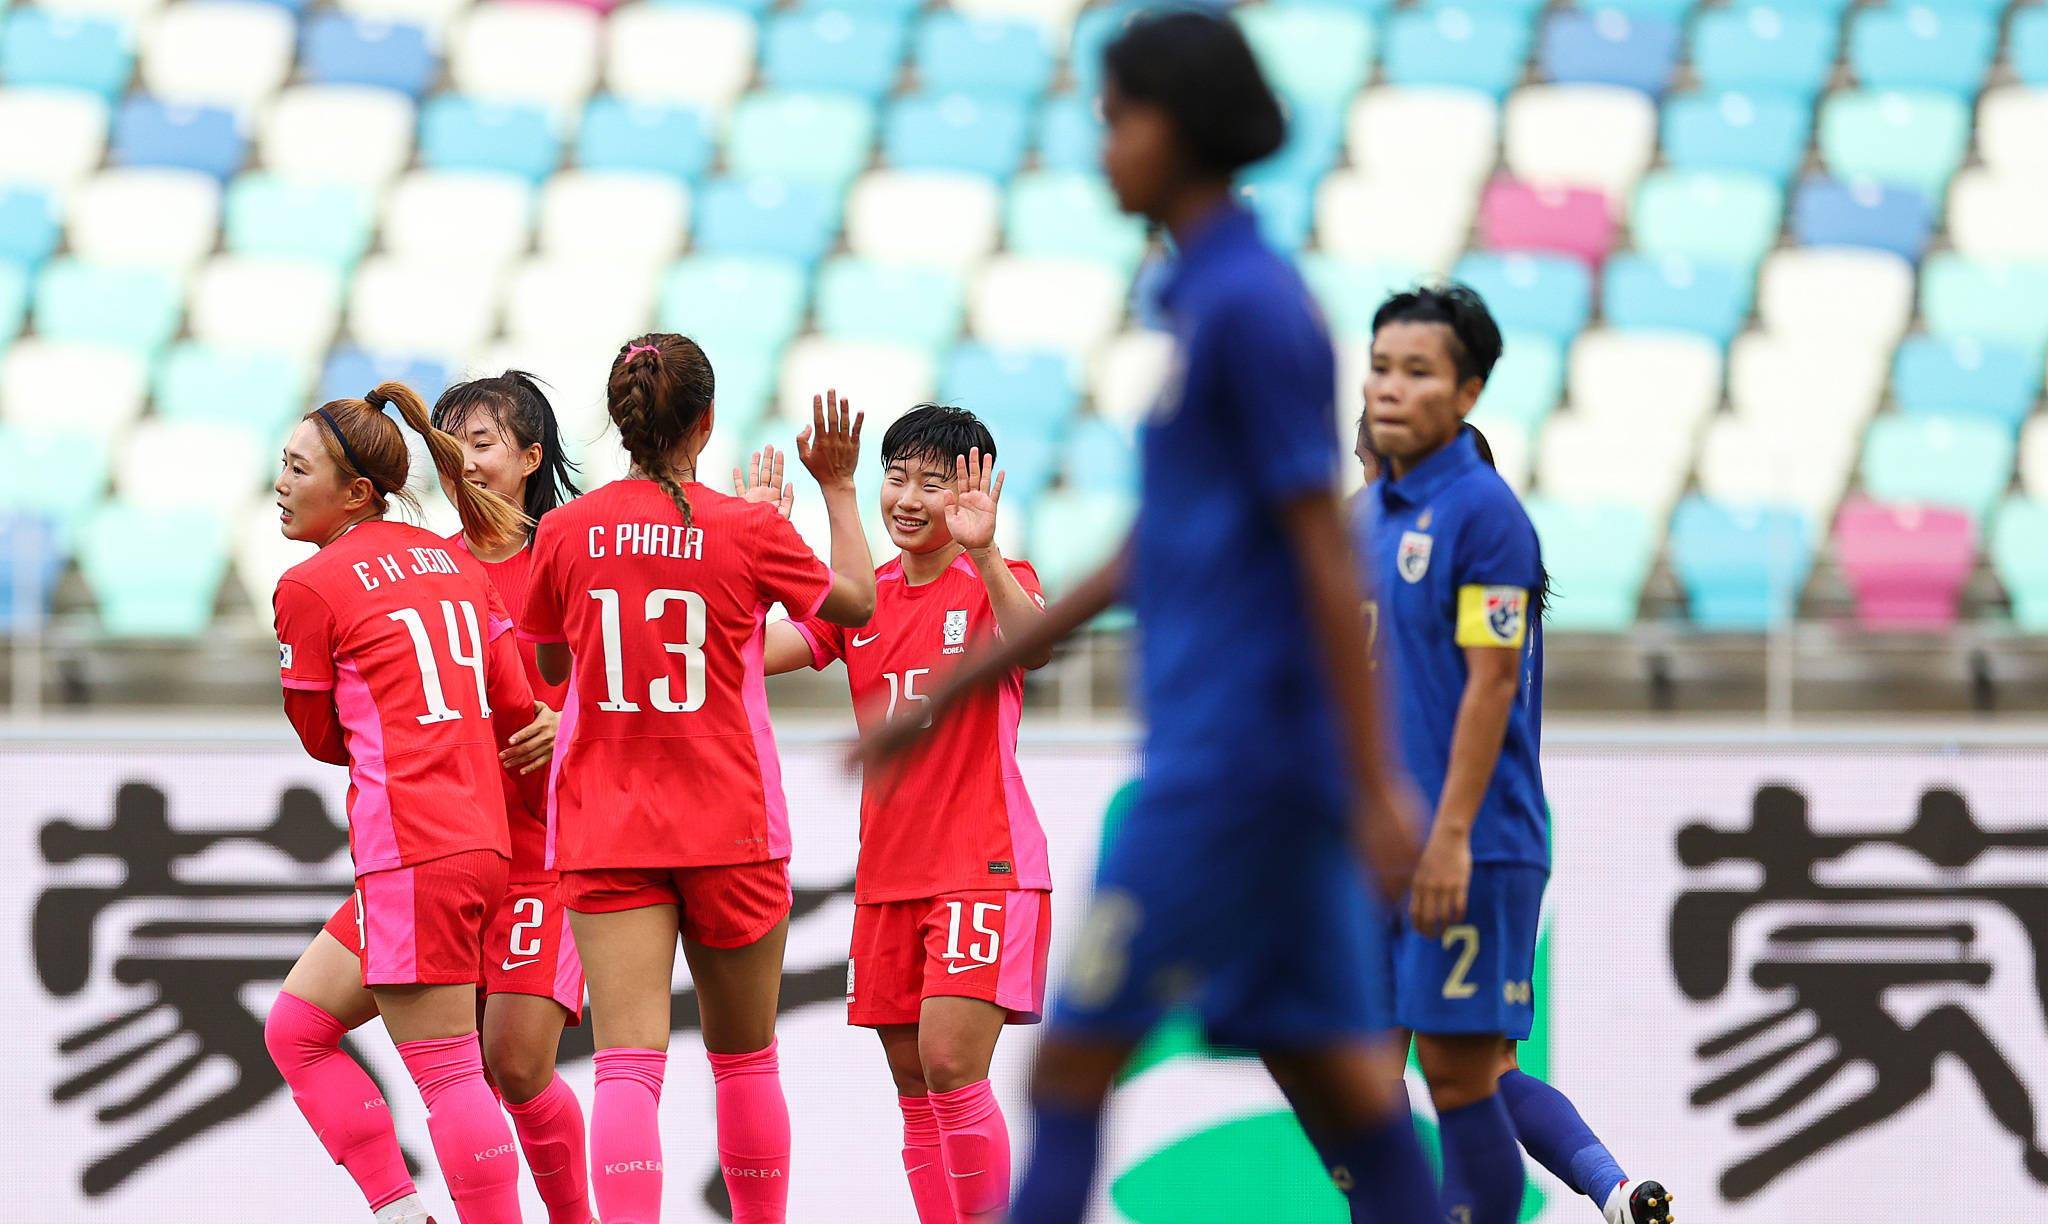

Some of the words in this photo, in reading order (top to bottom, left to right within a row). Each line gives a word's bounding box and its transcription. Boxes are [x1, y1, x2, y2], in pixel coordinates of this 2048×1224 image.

[588, 525, 605, 559] C
[615, 522, 704, 561] PHAIR
[352, 560, 380, 592] E
[378, 553, 406, 584] H
[407, 547, 460, 576] JEON
[386, 600, 494, 726] 14
[587, 588, 707, 713] 13
[942, 646, 965, 655] KOREA
[509, 897, 544, 956] 2
[940, 901, 1003, 964] 15
[1441, 923, 1480, 999] 2
[604, 1160, 663, 1176] KOREA
[721, 1166, 782, 1178] KOREA
